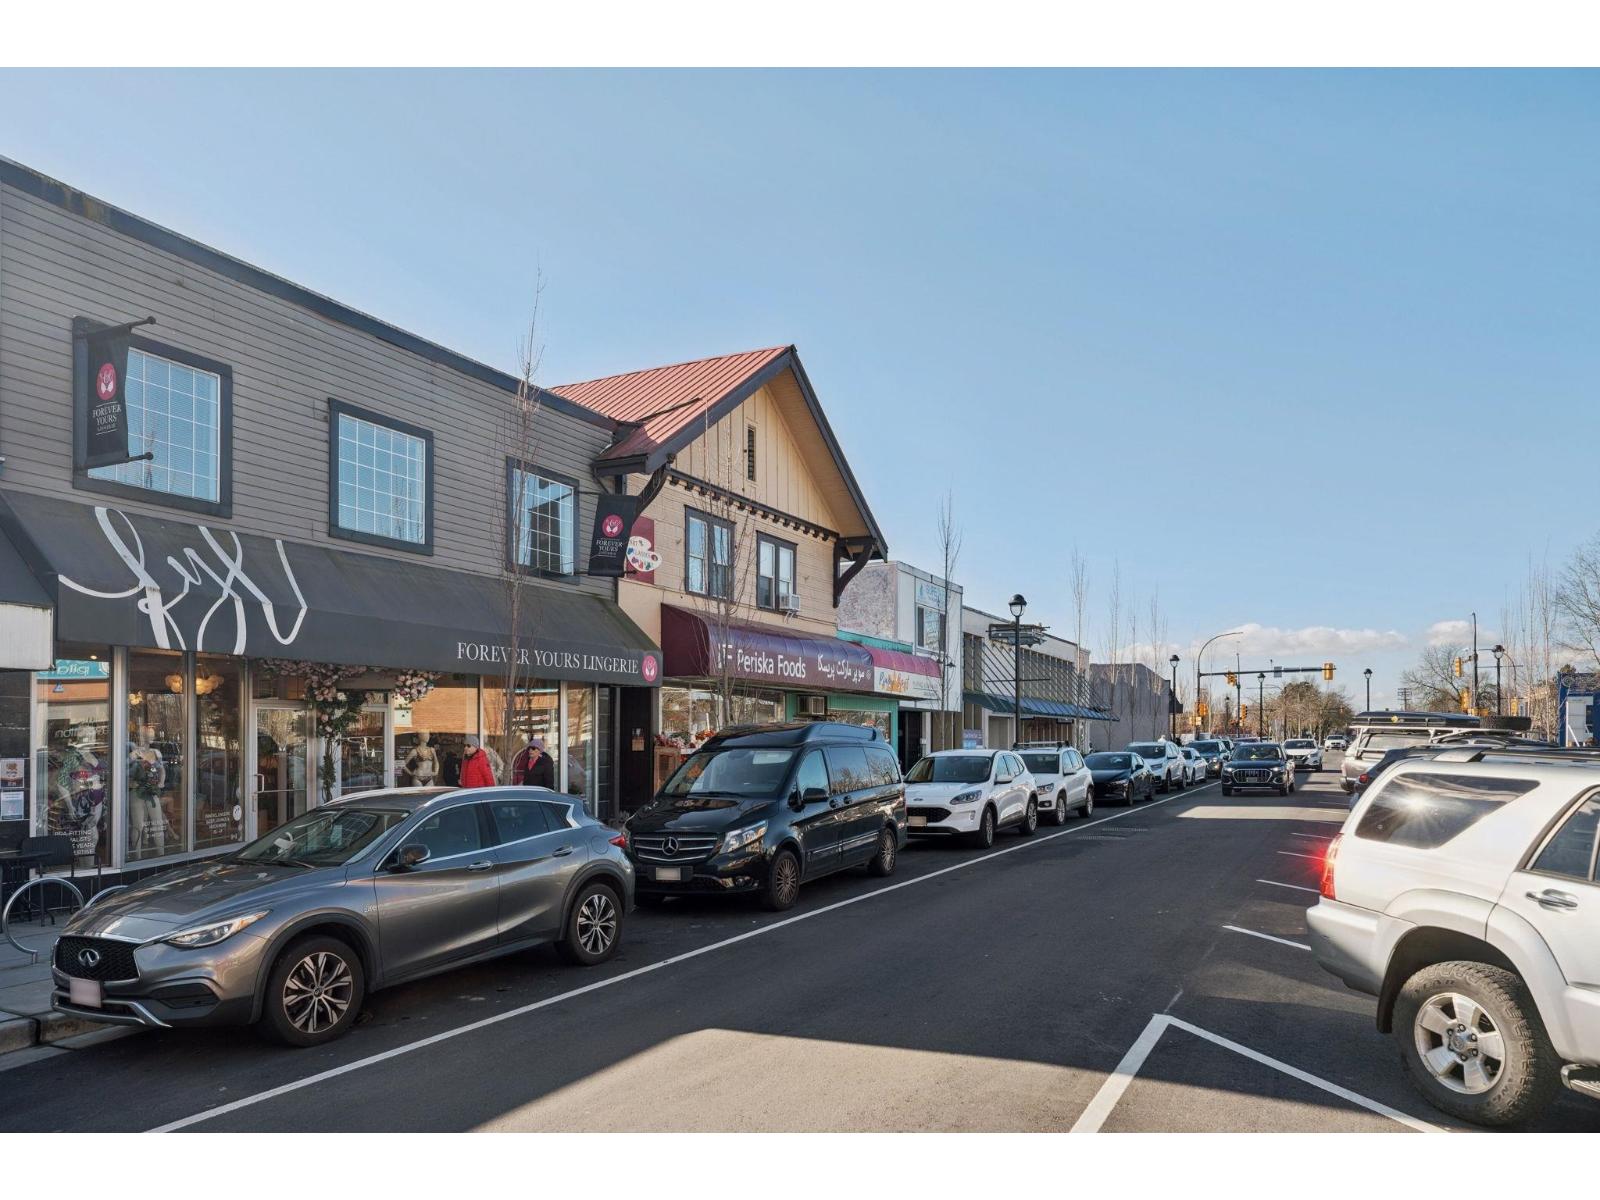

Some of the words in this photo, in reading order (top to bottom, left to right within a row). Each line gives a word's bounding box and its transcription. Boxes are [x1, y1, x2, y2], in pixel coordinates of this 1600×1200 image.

[92, 404, 122, 418] FOREVER
[96, 415, 117, 426] YOURS
[596, 539, 623, 548] FOREVER
[534, 649, 580, 669] YOURS
[583, 655, 639, 674] LINGERIE
[737, 649, 774, 676] Periska
[777, 655, 806, 679] Foods
